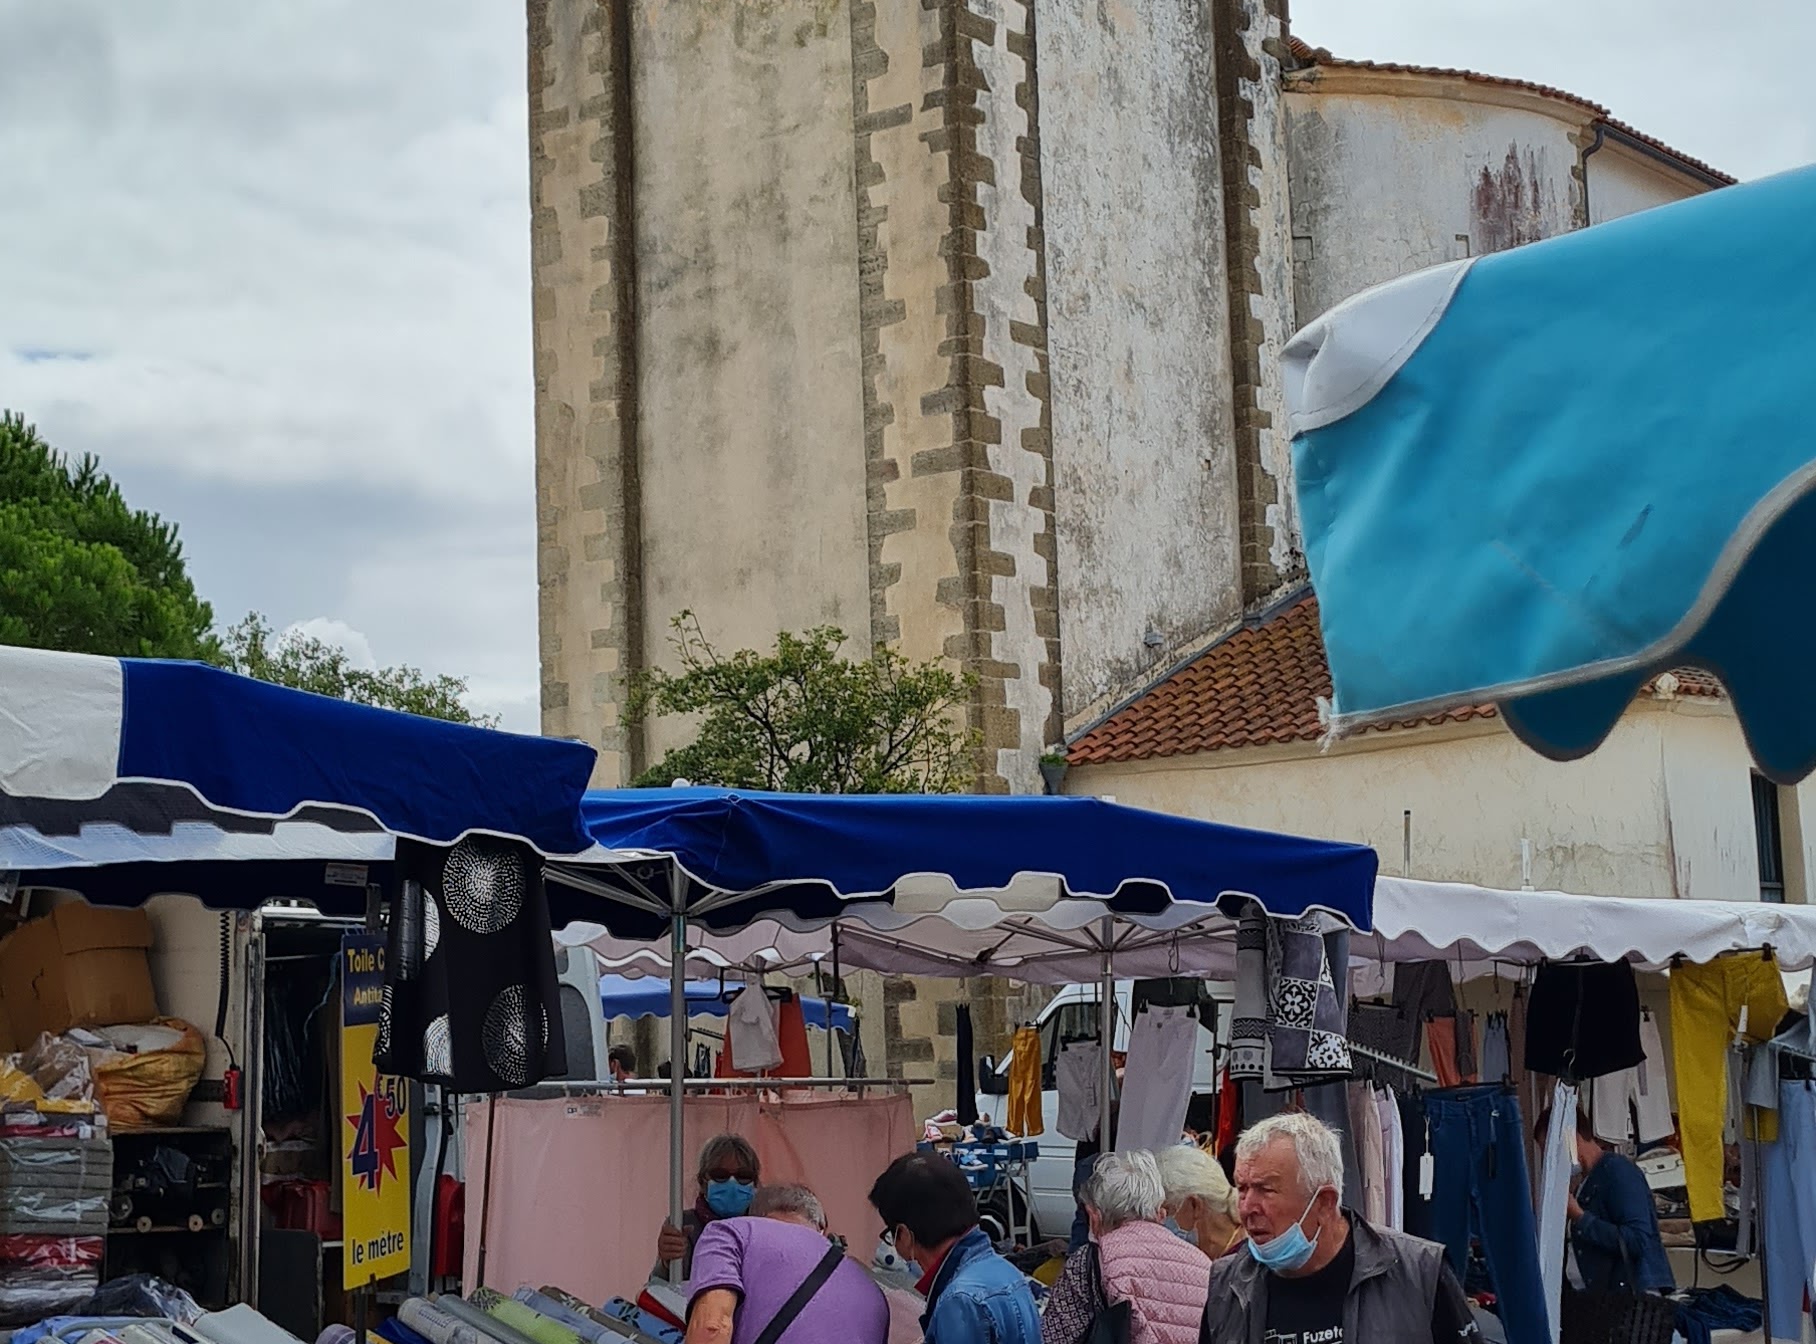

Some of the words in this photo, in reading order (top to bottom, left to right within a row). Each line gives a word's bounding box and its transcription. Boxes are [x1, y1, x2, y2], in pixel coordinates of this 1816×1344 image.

[347, 948, 375, 973] Toile
[352, 1239, 364, 1265] le
[368, 1230, 404, 1259] mètre
